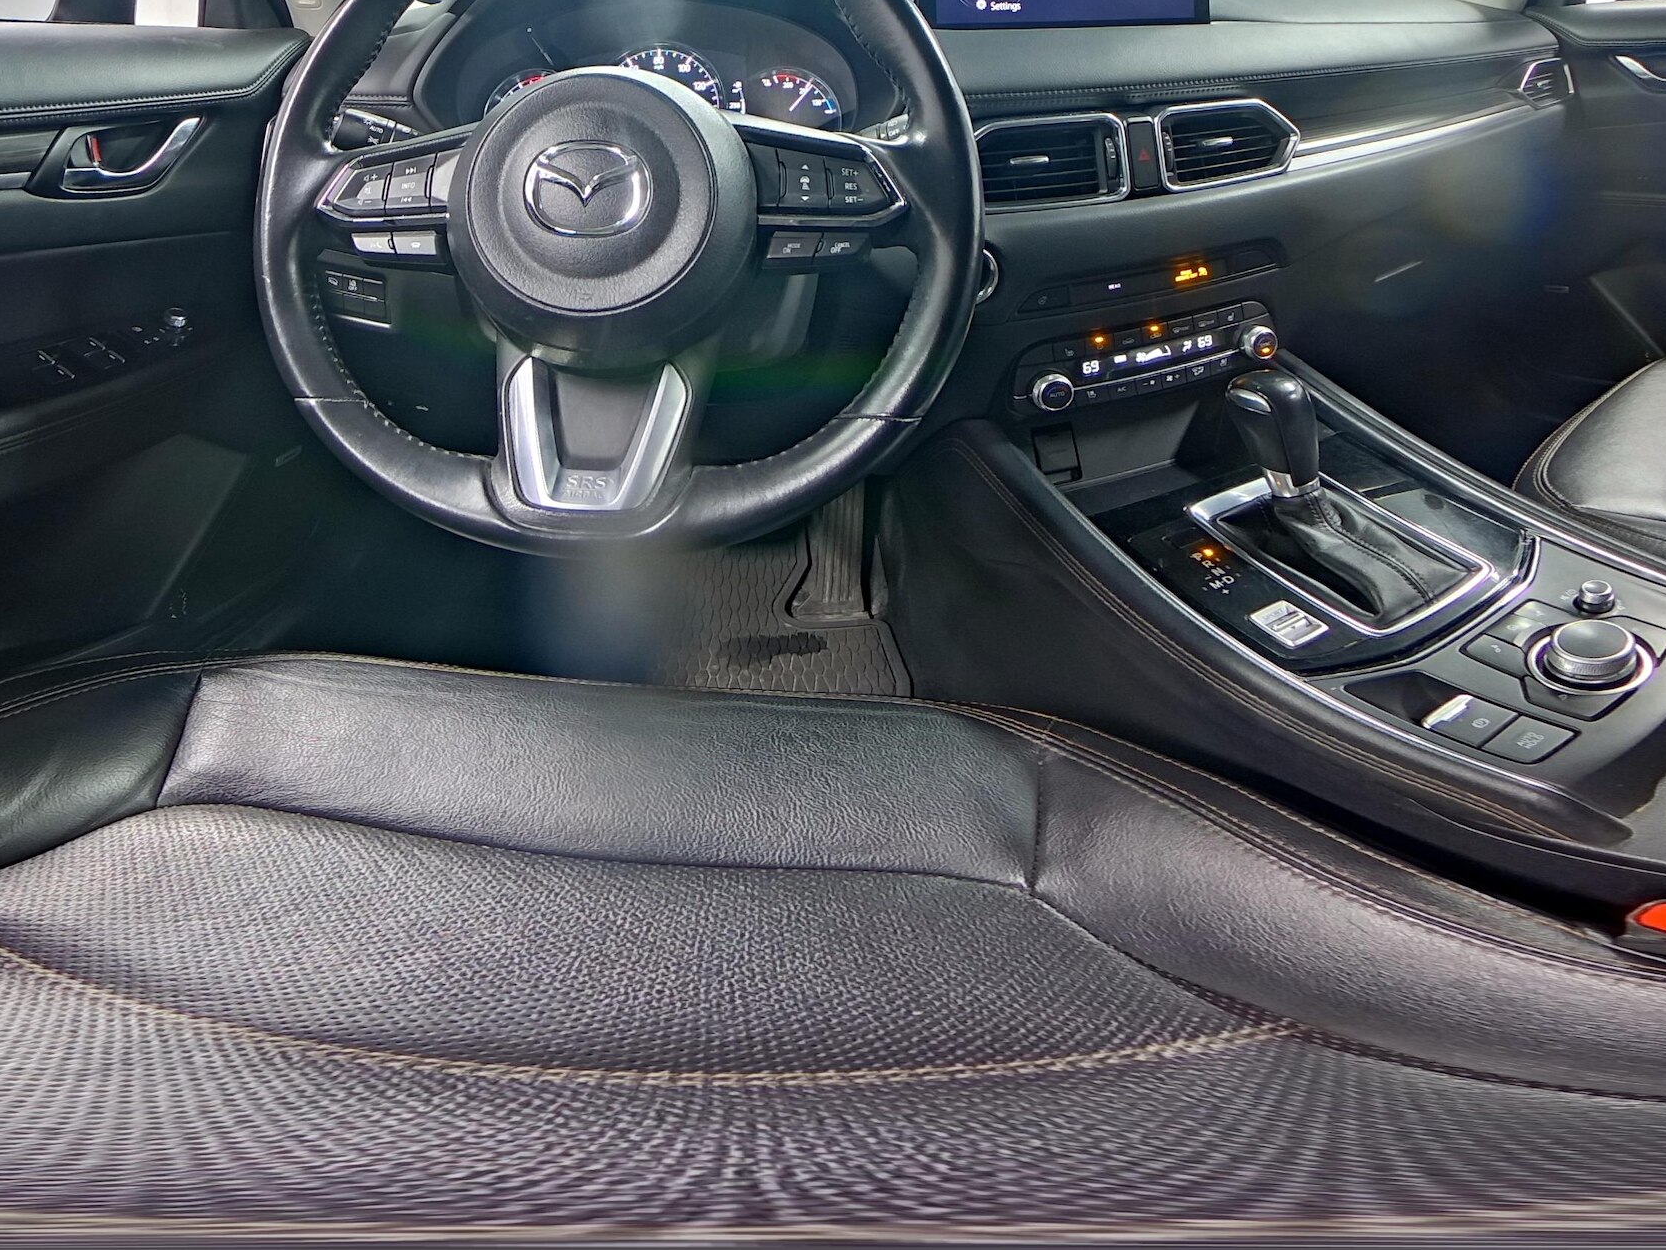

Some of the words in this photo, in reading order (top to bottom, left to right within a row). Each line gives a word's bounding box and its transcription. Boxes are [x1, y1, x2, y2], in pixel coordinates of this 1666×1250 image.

[990, 1, 1022, 12] Settings
[677, 64, 691, 72] 100
[693, 81, 707, 91] 120
[369, 125, 384, 134] AUTO
[841, 167, 859, 177] SET+
[401, 182, 416, 190] INFO
[844, 182, 858, 191] RES
[1197, 334, 1213, 348] 69
[1082, 360, 1100, 374] 69
[566, 474, 606, 489] SRS
[1190, 552, 1203, 561] P
[1202, 560, 1215, 568] R
[1211, 567, 1226, 577] N
